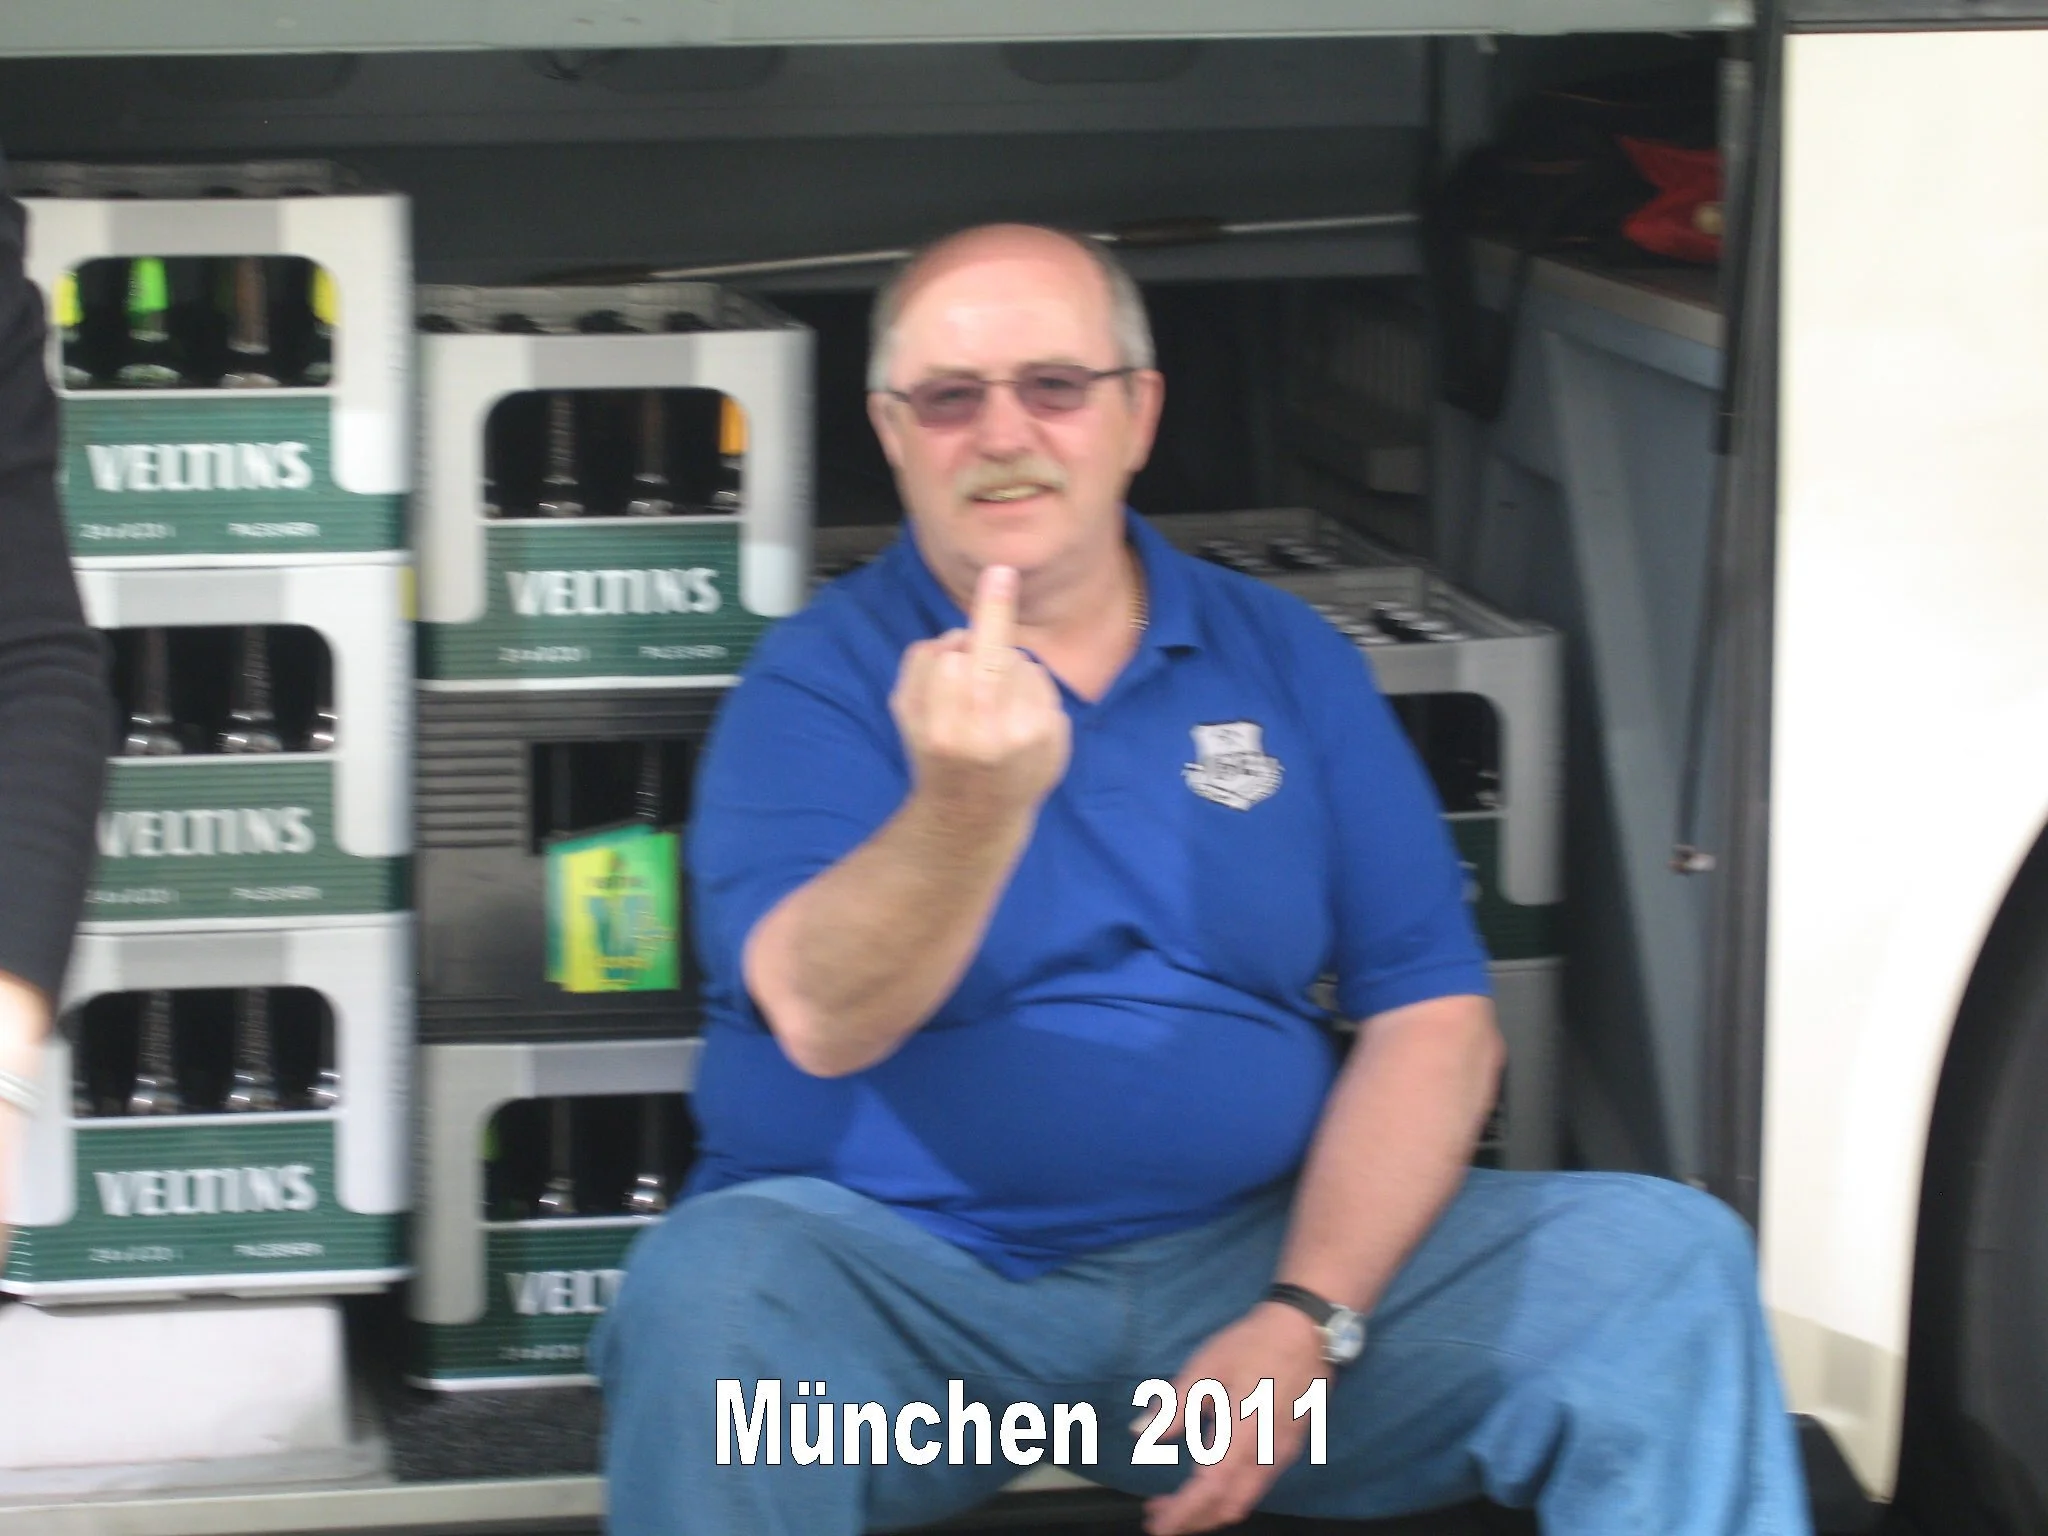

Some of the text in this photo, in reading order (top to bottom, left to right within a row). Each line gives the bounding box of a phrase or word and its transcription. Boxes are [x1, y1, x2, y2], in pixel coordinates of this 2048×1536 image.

[87, 441, 312, 492] VELTINS
[505, 567, 722, 617] VELTINS
[93, 1164, 318, 1217] VELTINS
